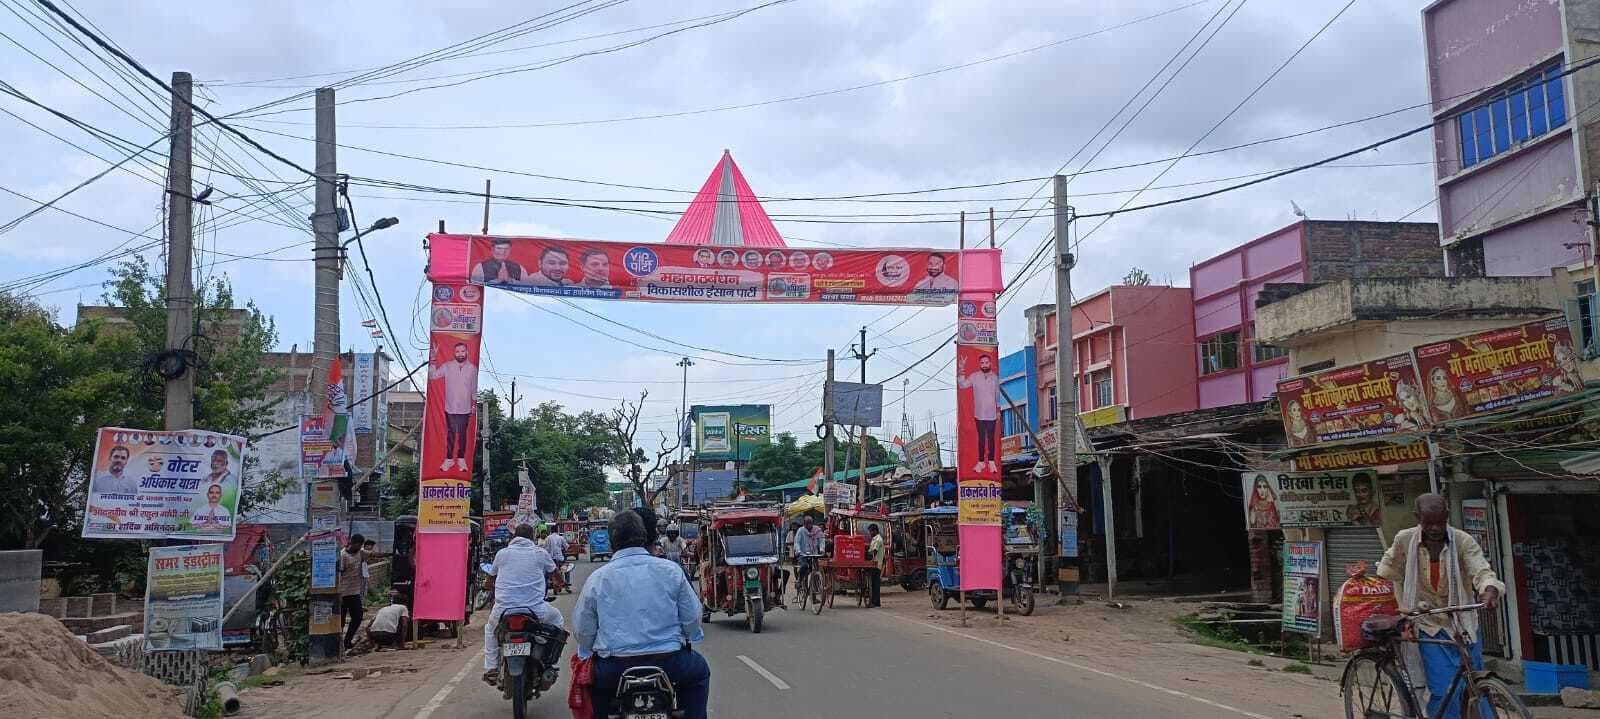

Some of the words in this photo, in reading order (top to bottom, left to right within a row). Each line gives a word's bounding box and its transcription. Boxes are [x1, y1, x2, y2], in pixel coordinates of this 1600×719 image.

[630, 252, 649, 262] VIP
[660, 271, 740, 285] महागठबंधन
[647, 283, 704, 296] विकासशील
[706, 286, 735, 298] इंसान
[736, 287, 757, 298] पार्टी
[167, 456, 201, 472] वोटर
[139, 474, 177, 490] अधिकार
[179, 477, 201, 490] यात्रा
[1277, 474, 1315, 491] शिखा
[1317, 473, 1348, 490] स्नेहा
[423, 482, 456, 498] सकलदेव
[140, 508, 158, 520] राहुल
